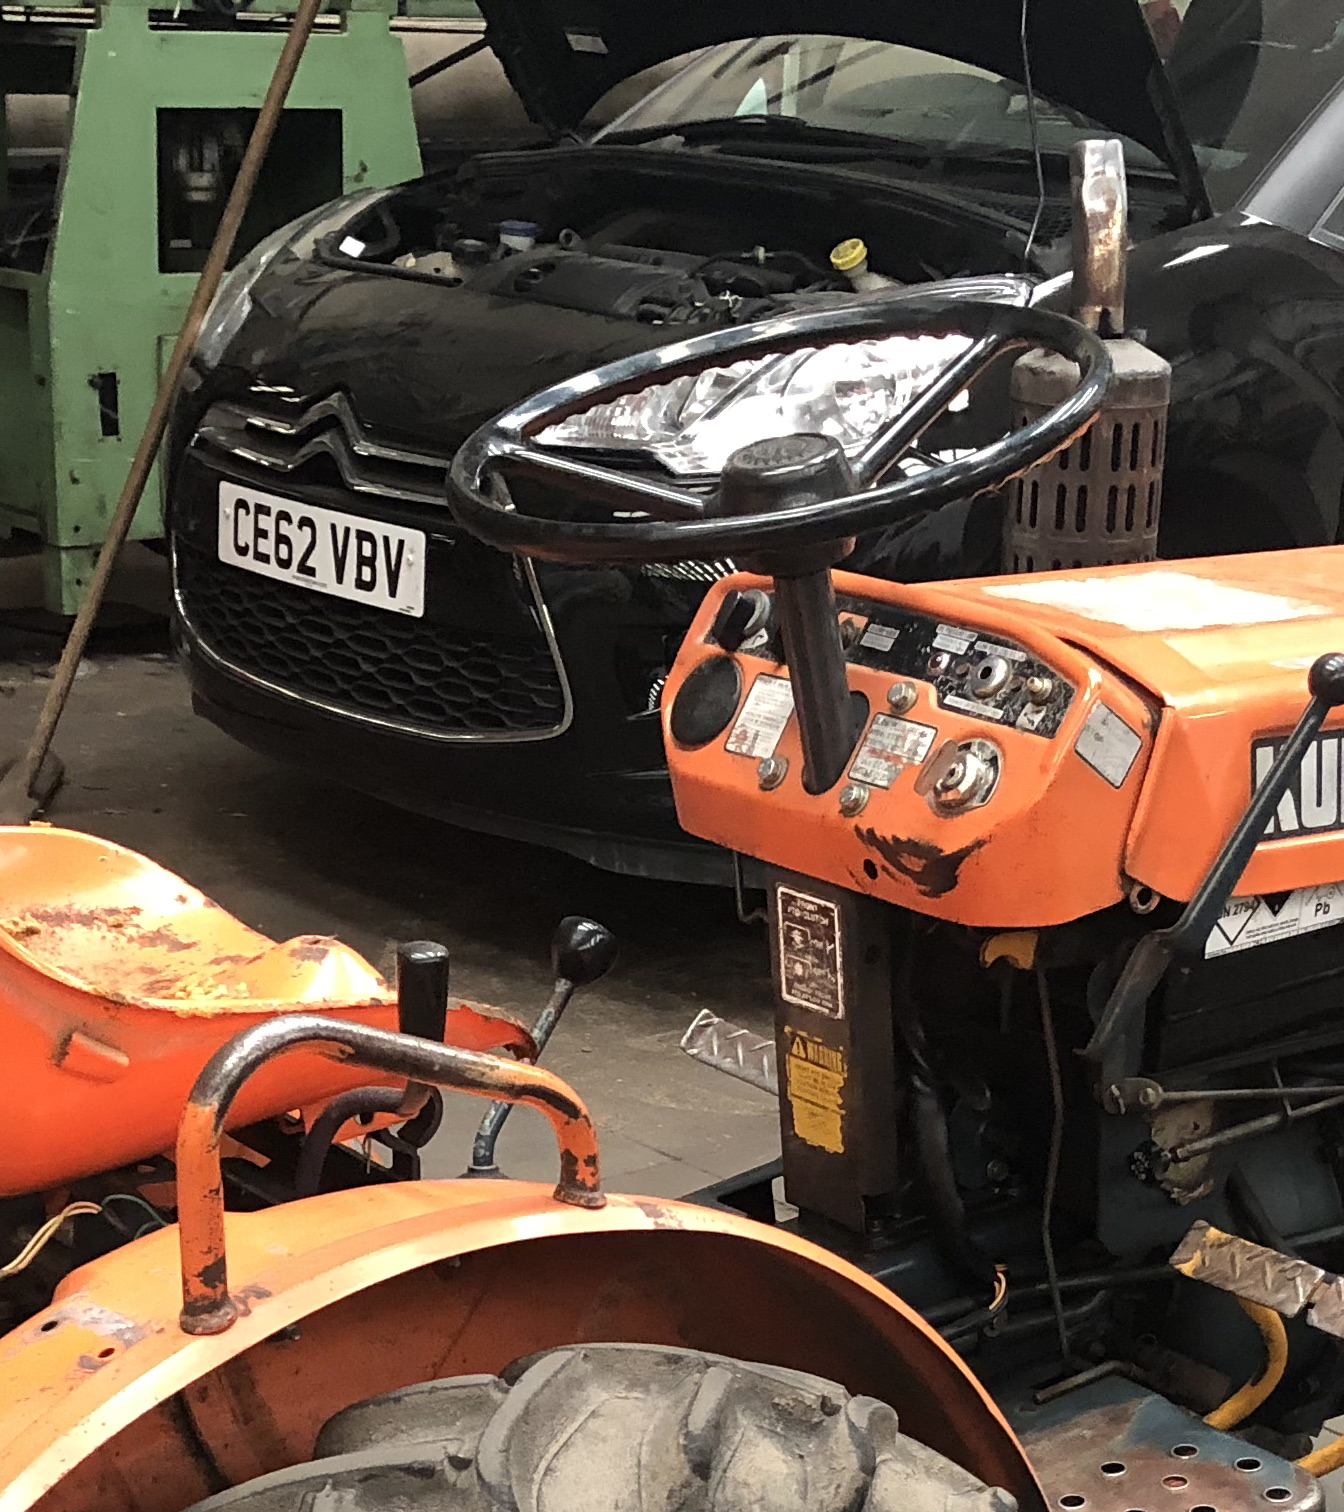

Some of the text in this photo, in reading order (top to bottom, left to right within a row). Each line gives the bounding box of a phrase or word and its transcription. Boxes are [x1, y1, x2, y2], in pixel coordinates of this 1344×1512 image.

[233, 498, 405, 599] CE62 VBV
[1314, 902, 1332, 918] Pb
